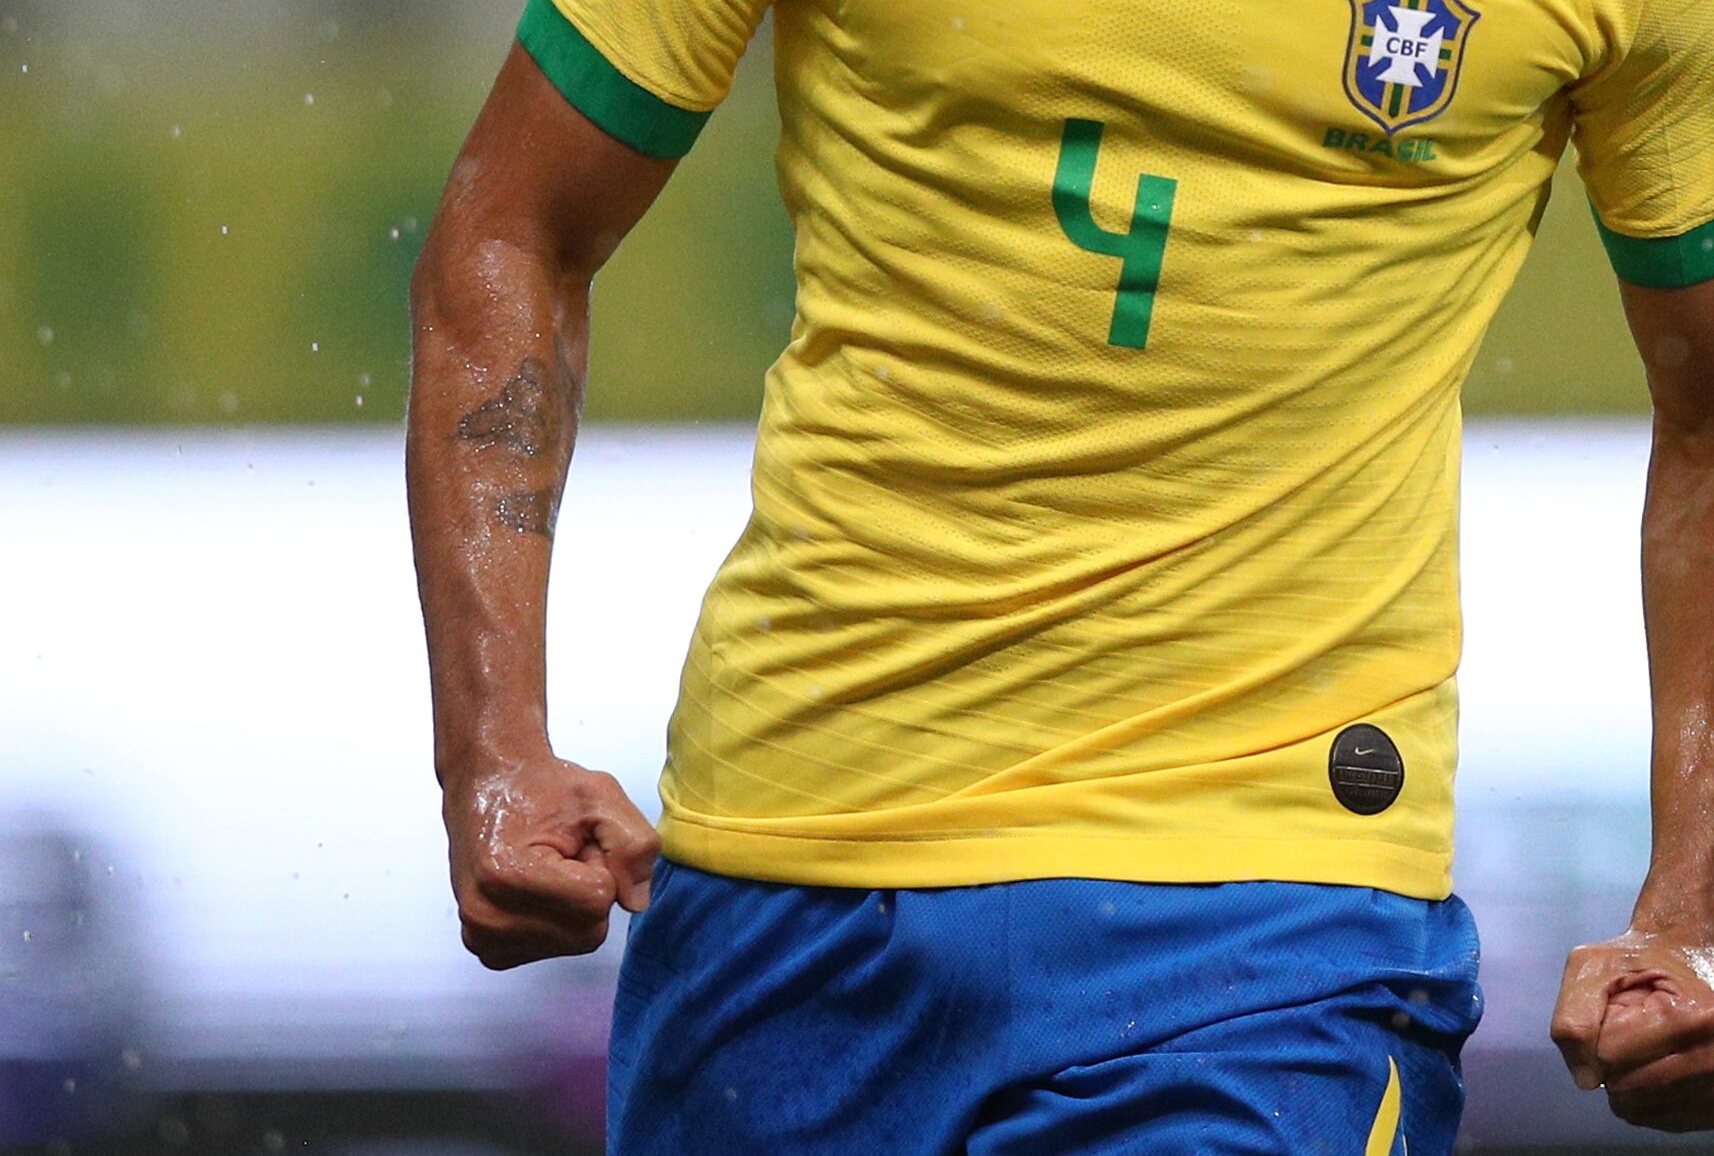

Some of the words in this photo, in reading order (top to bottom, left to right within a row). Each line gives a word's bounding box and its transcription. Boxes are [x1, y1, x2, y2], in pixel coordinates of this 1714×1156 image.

[1386, 36, 1429, 59] CBF
[1322, 128, 1437, 162] BRASIL
[1051, 117, 1179, 351] 4
